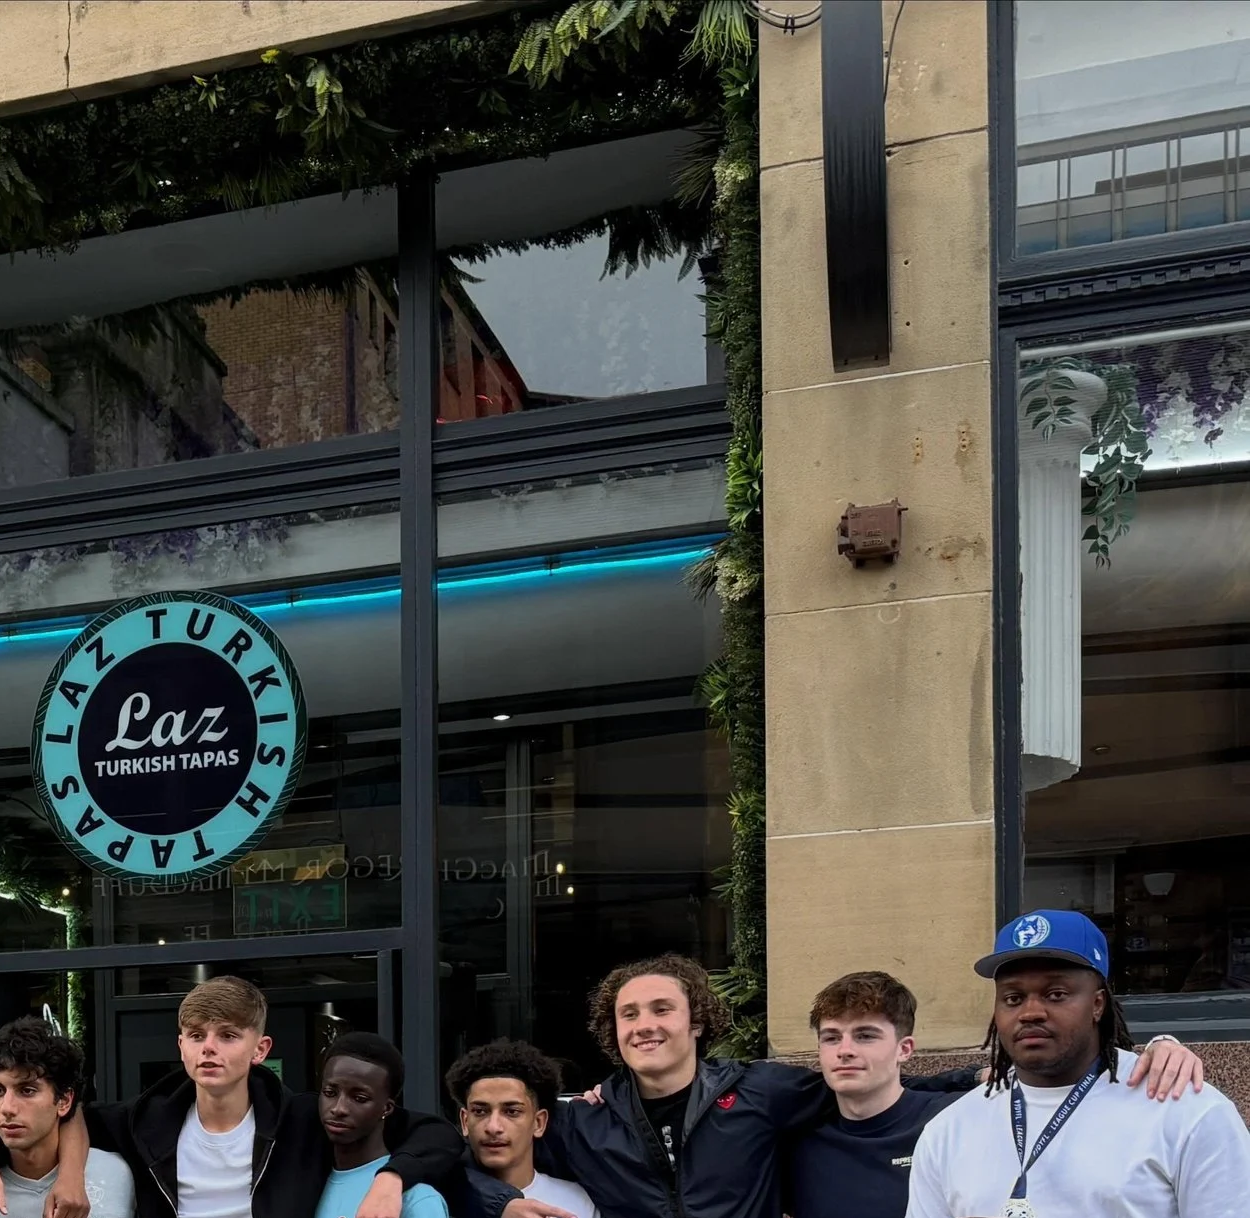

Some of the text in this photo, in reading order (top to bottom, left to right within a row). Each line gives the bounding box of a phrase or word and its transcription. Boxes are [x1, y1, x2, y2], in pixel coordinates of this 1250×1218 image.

[45, 607, 289, 869] LAZ TURKISH TAPAS
[104, 691, 229, 752] Laz
[94, 748, 240, 777] TURKISH TAPAS
[1050, 1104, 1071, 1131] LEAGUE
[1068, 1090, 1080, 1105] CUP
[1078, 1073, 1096, 1092] FINAL
